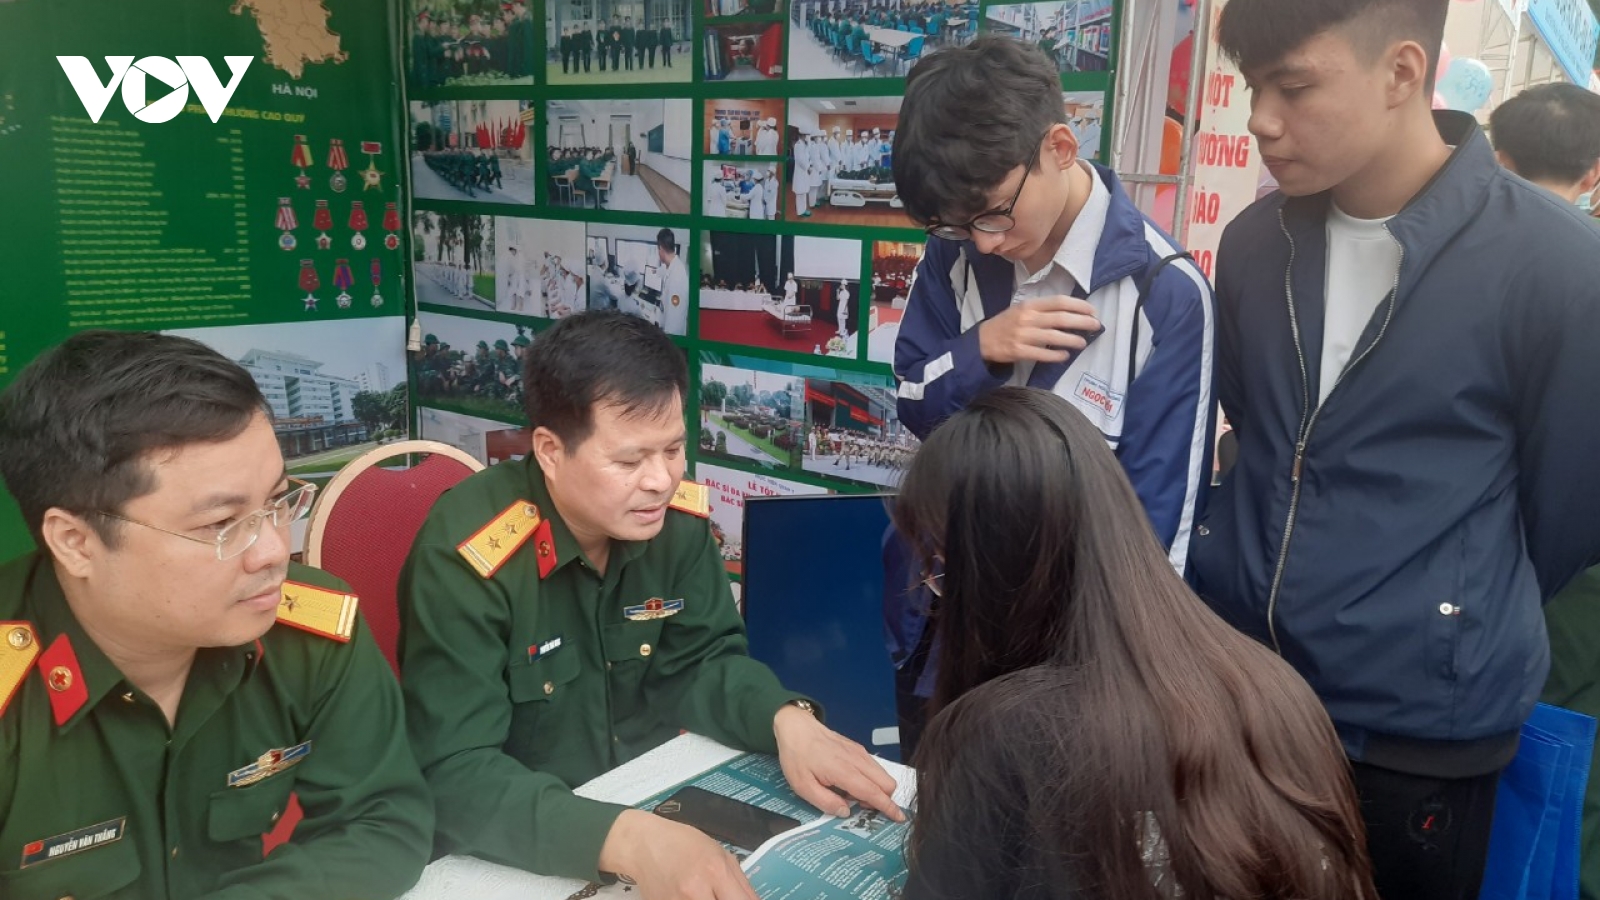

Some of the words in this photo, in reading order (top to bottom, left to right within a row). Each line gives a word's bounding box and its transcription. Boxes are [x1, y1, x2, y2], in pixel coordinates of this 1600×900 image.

[271, 83, 292, 96] HÀ
[294, 86, 318, 100] NỘI
[261, 110, 282, 121] CAO
[48, 837, 79, 857] NGUYỄN
[79, 834, 95, 848] VĂN
